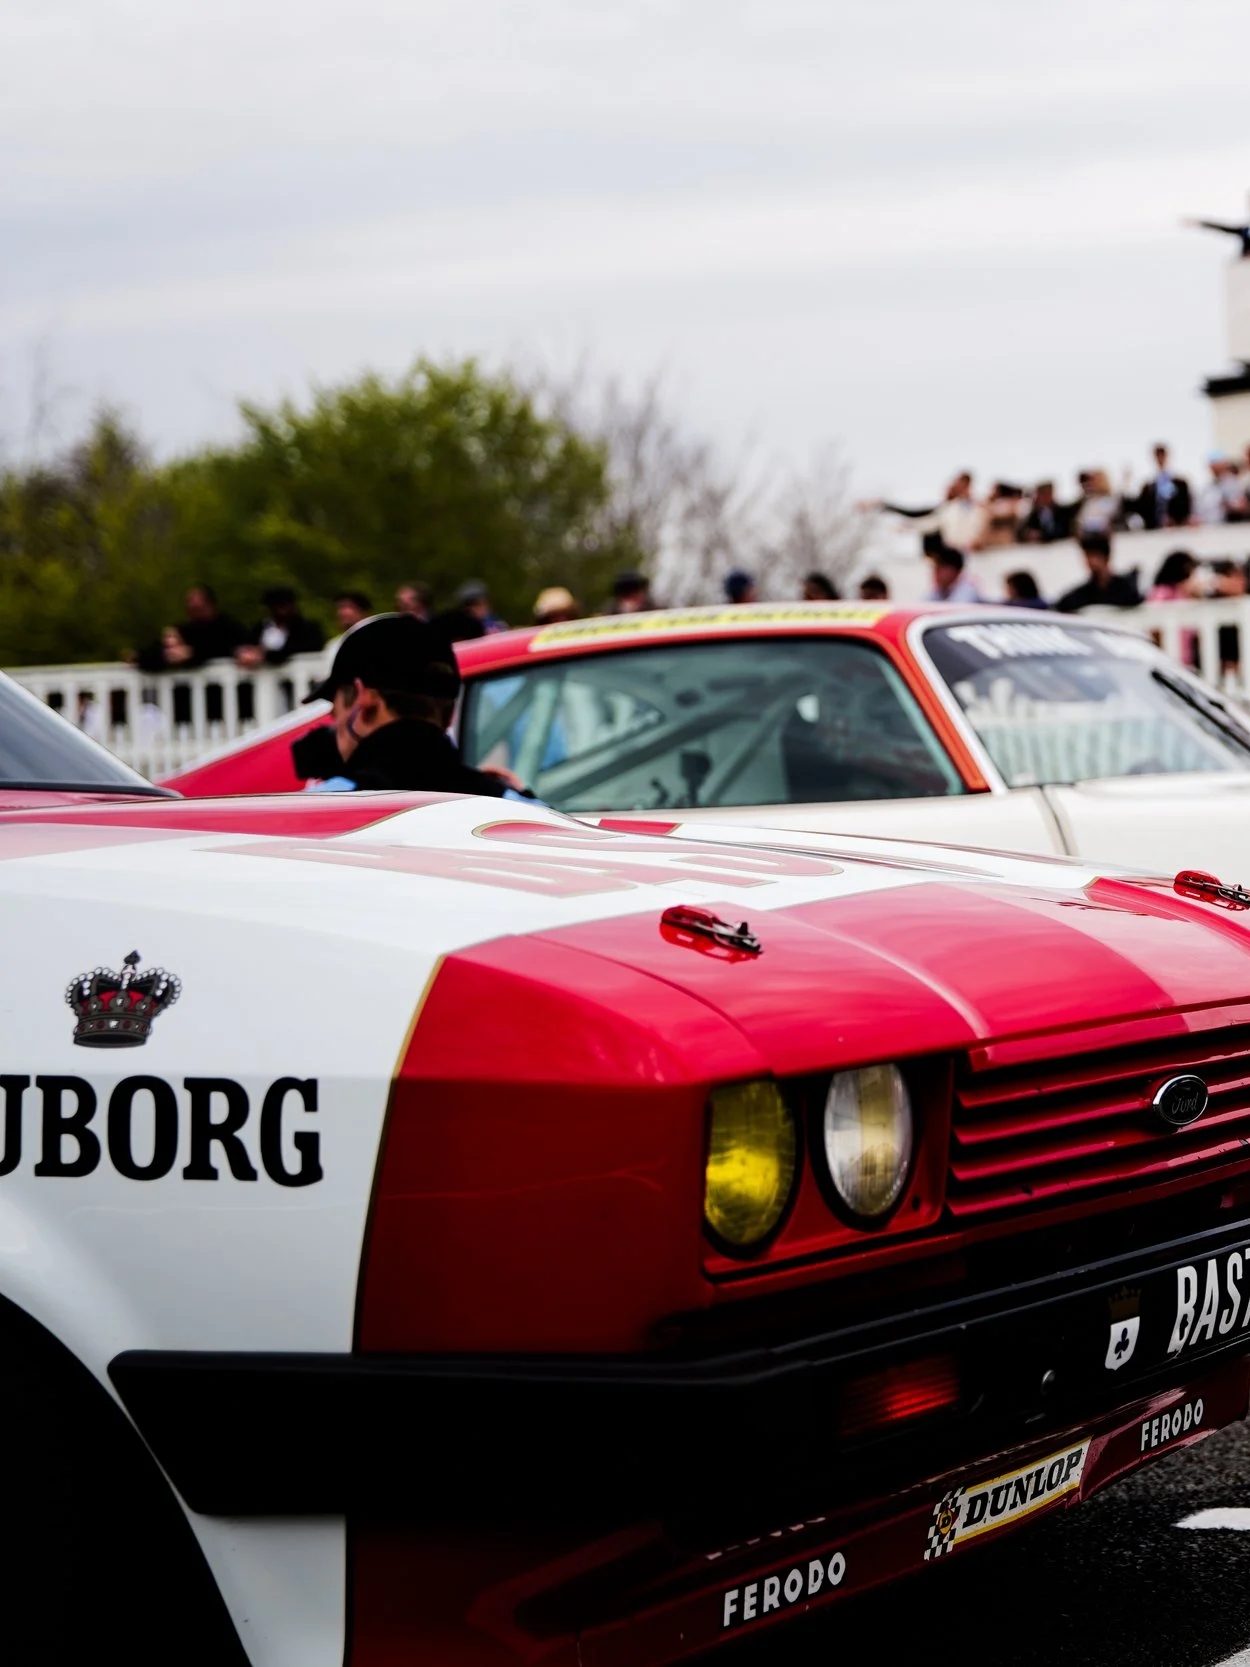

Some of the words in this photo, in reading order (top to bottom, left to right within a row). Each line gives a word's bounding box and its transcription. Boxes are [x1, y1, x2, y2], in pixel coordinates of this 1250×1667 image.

[1140, 1397, 1205, 1452] FERODO
[961, 1447, 1083, 1529] DUNLOP
[723, 1551, 847, 1627] FERODO
